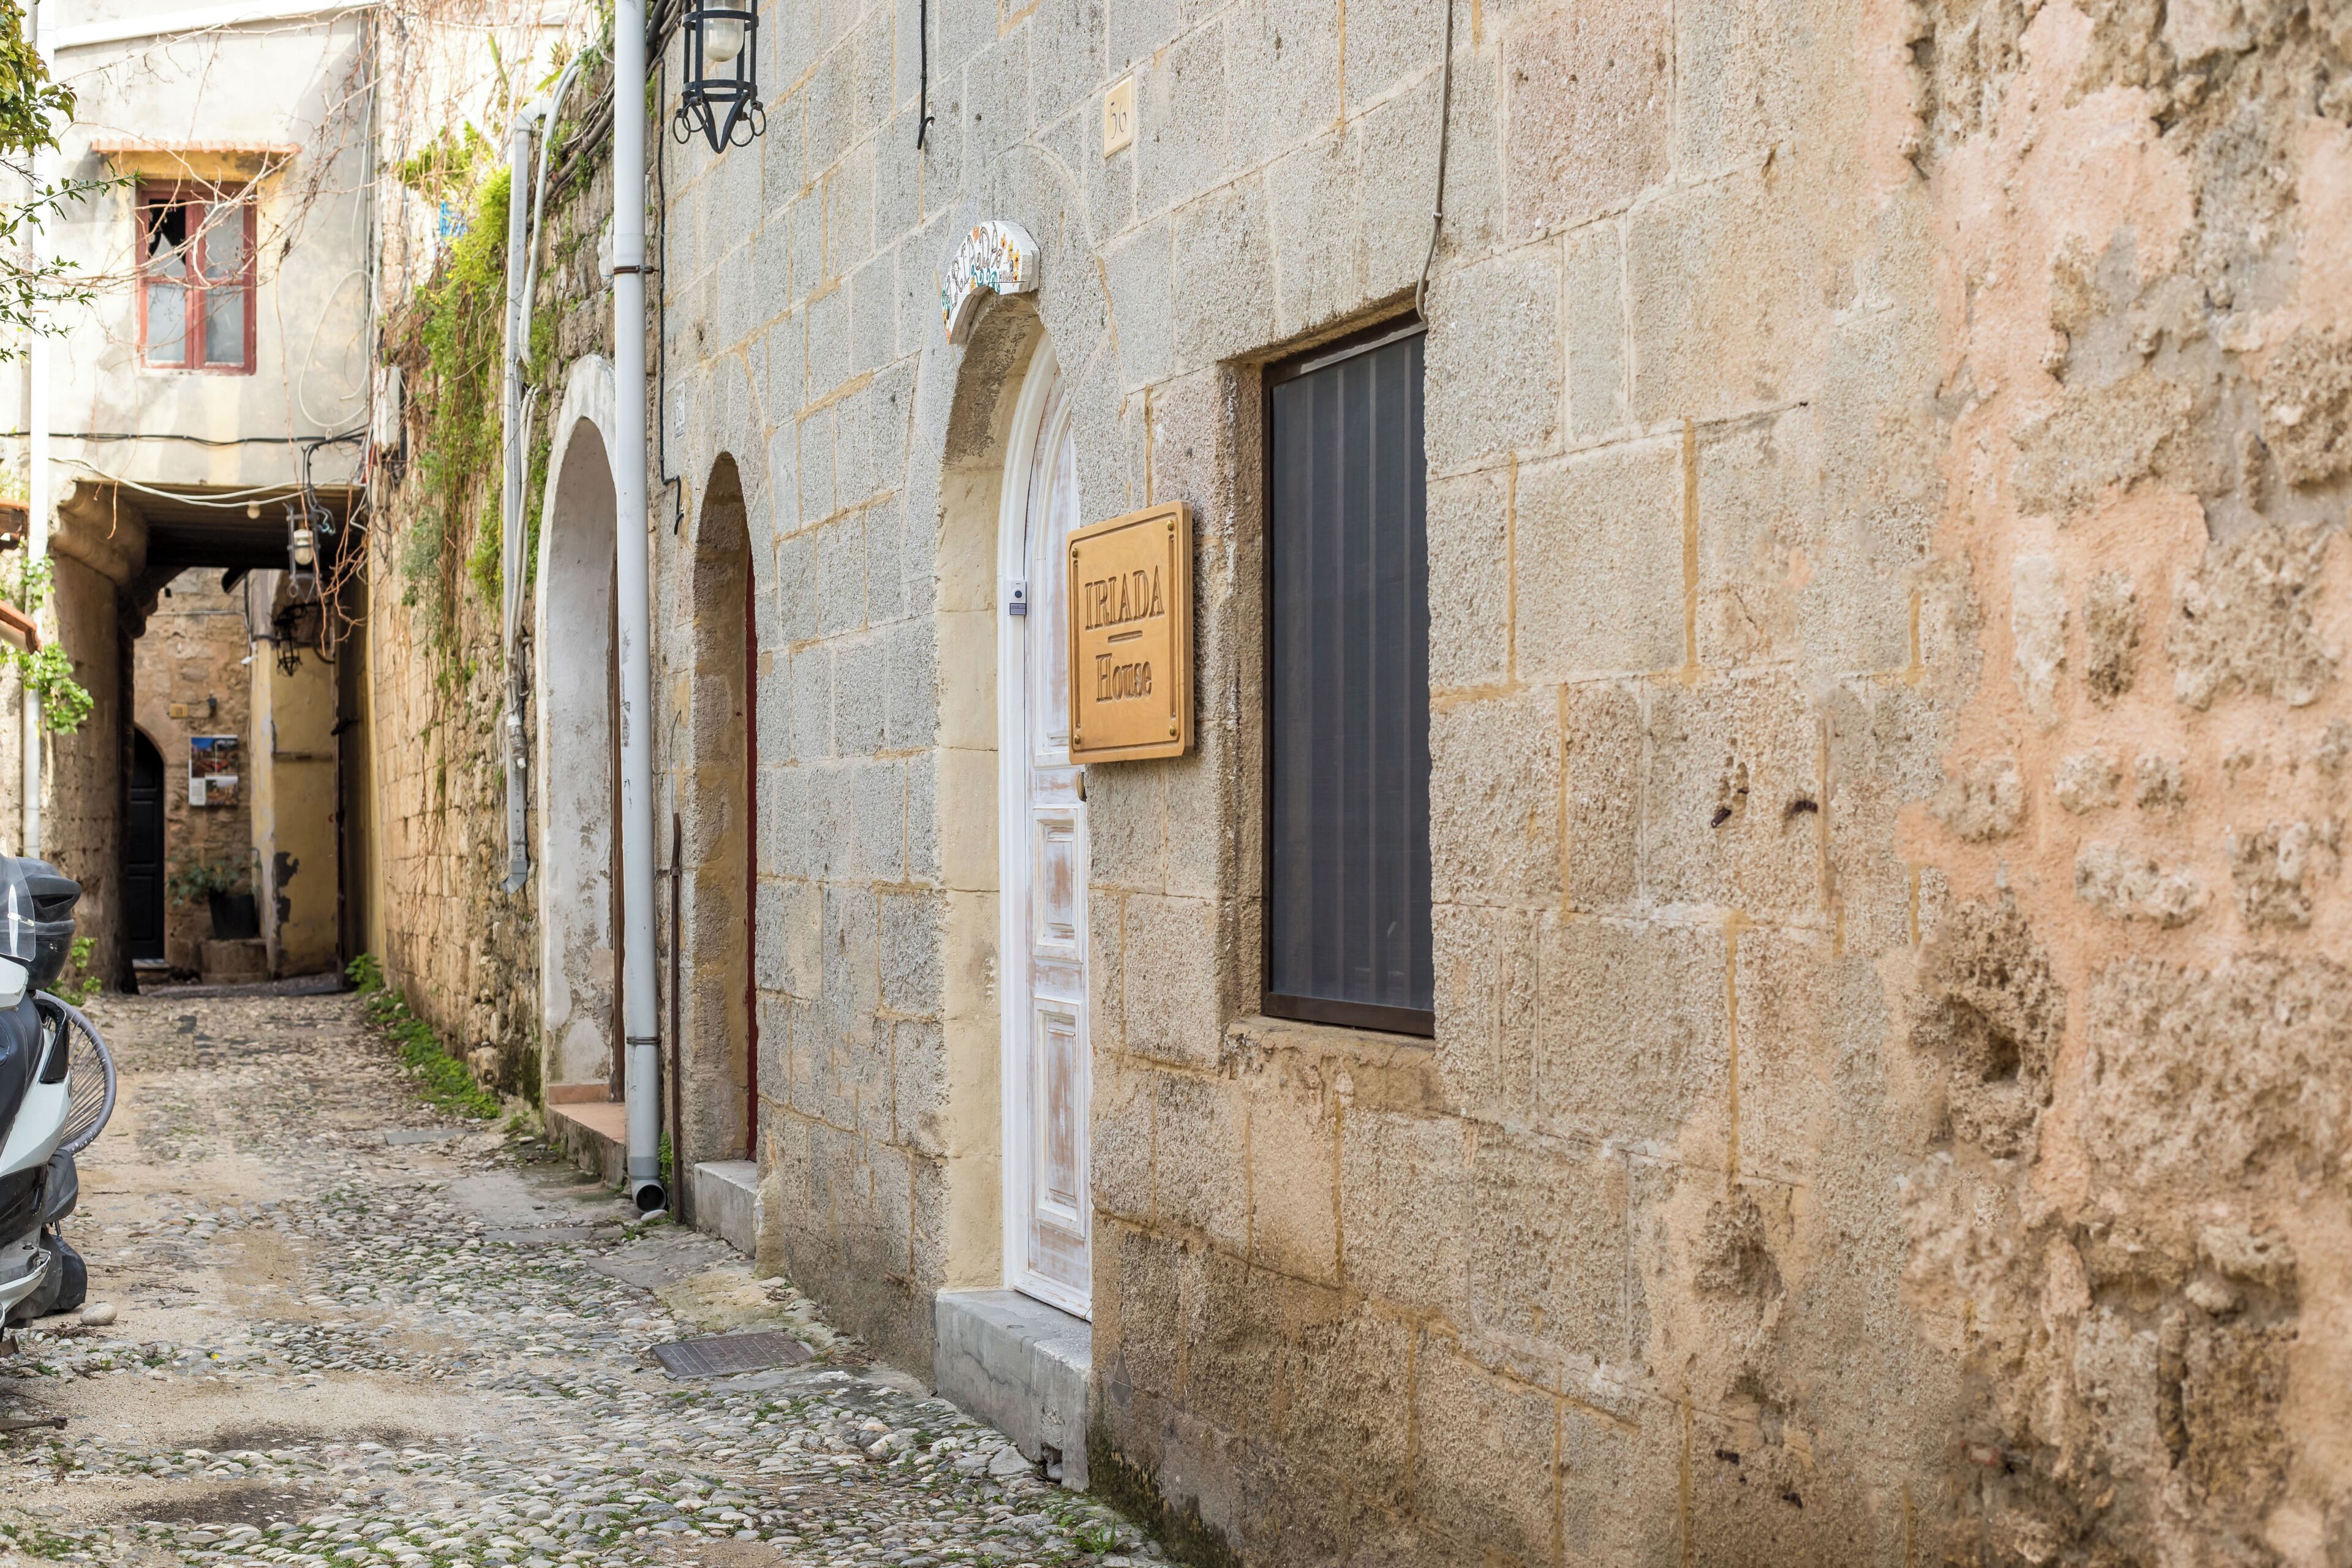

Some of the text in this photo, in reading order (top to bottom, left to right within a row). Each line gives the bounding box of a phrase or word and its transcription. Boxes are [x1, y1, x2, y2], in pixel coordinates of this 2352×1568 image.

[1110, 101, 1127, 140] 56
[1085, 564, 1165, 631] IRIADA
[1096, 652, 1152, 703] House
